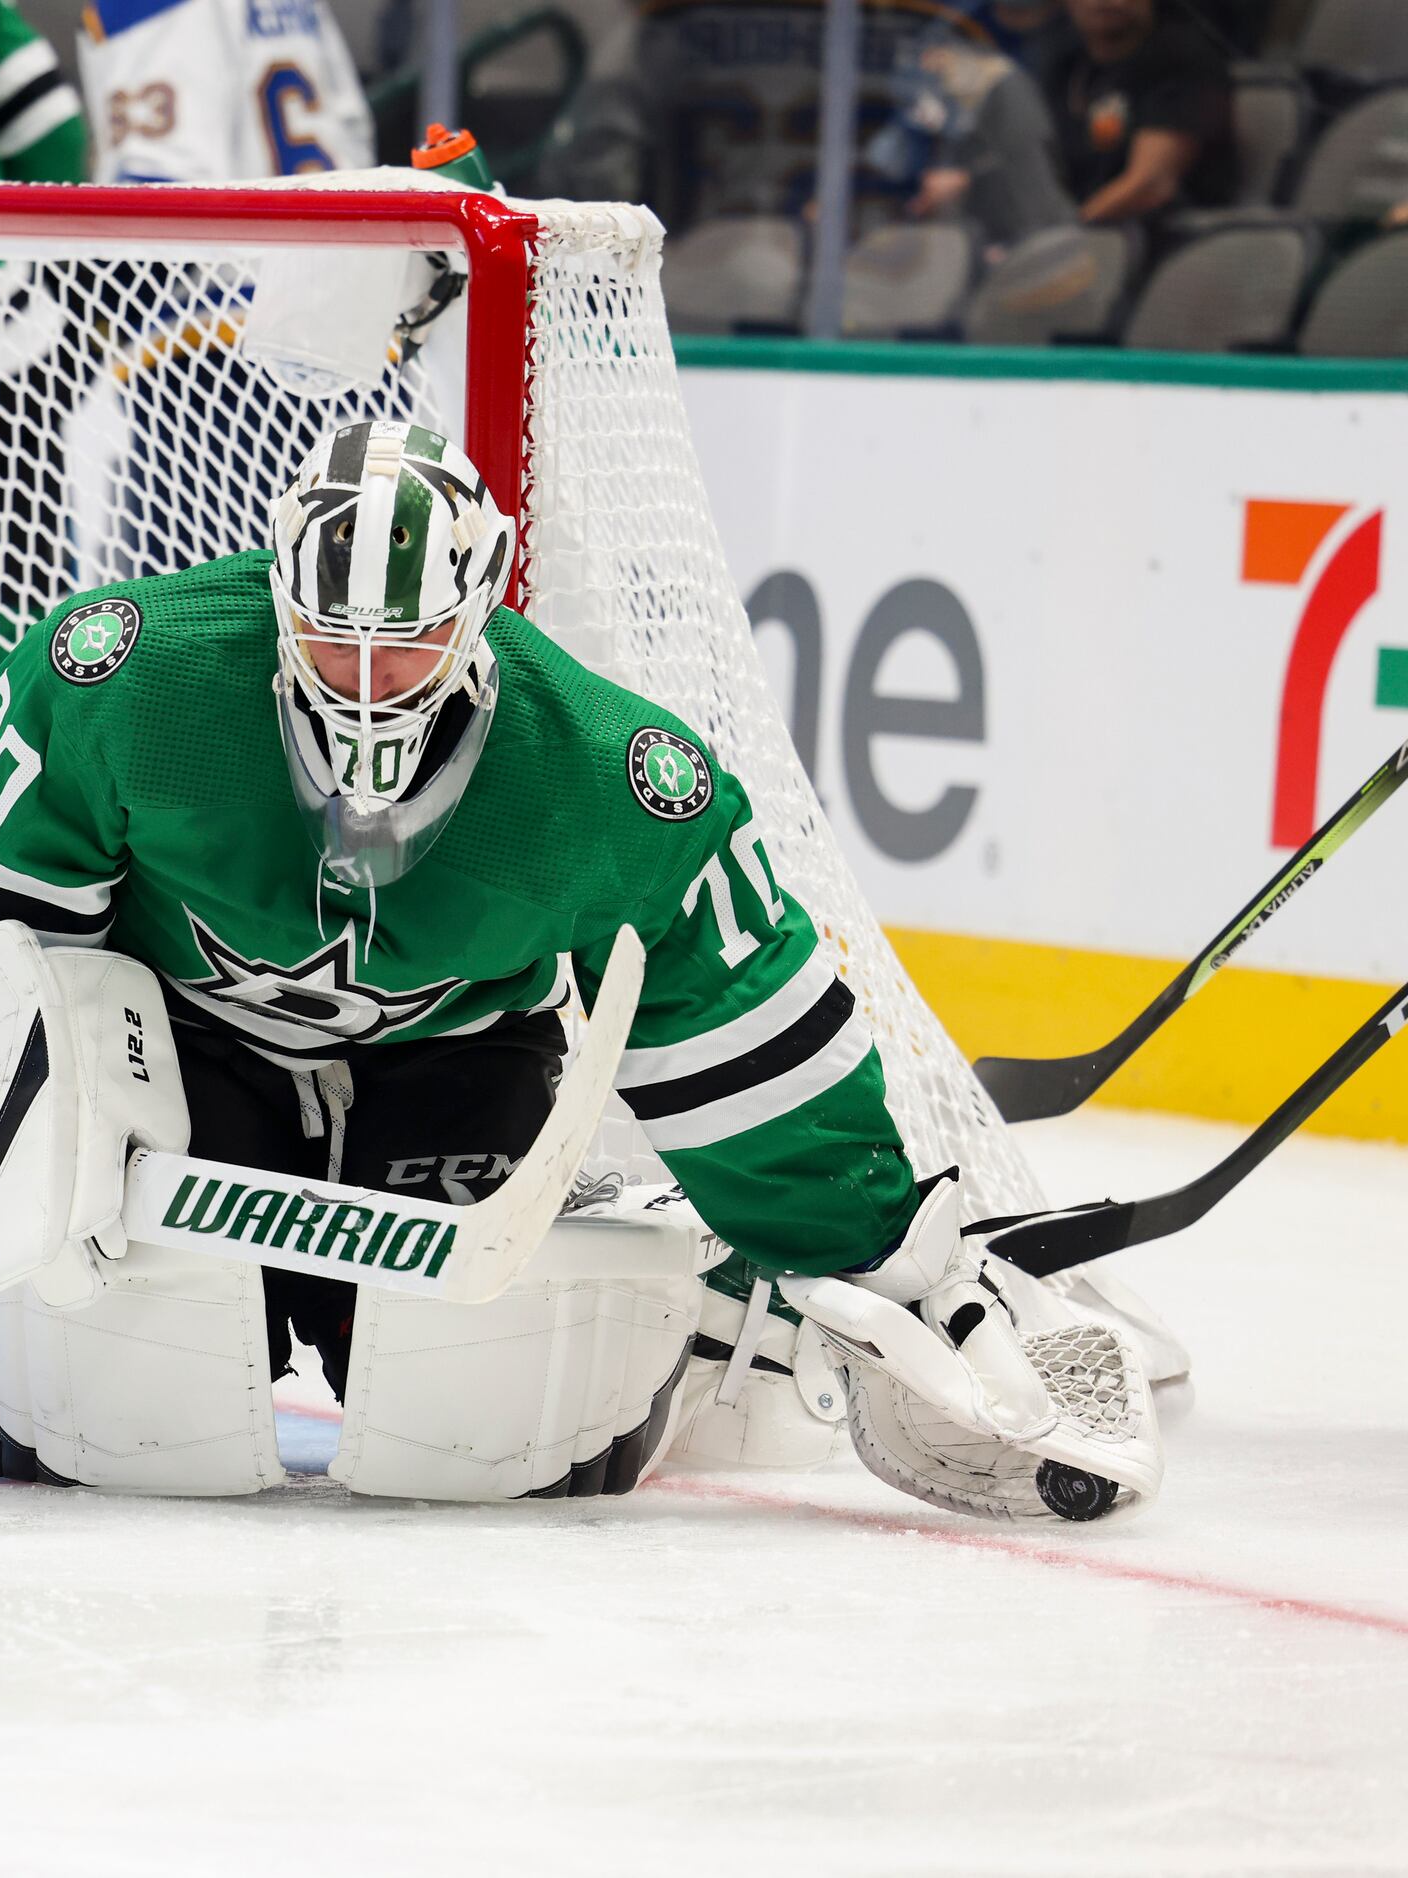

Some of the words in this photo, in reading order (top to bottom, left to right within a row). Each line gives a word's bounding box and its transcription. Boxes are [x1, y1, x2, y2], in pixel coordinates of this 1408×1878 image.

[100, 604, 133, 668] DALLAS
[328, 602, 404, 619] BAUER
[56, 616, 86, 677] STARS
[335, 731, 404, 793] 70
[635, 734, 671, 802] DALLAS
[673, 753, 707, 814] STARS
[124, 1007, 150, 1083] L12.2
[386, 1154, 525, 1185] CCM
